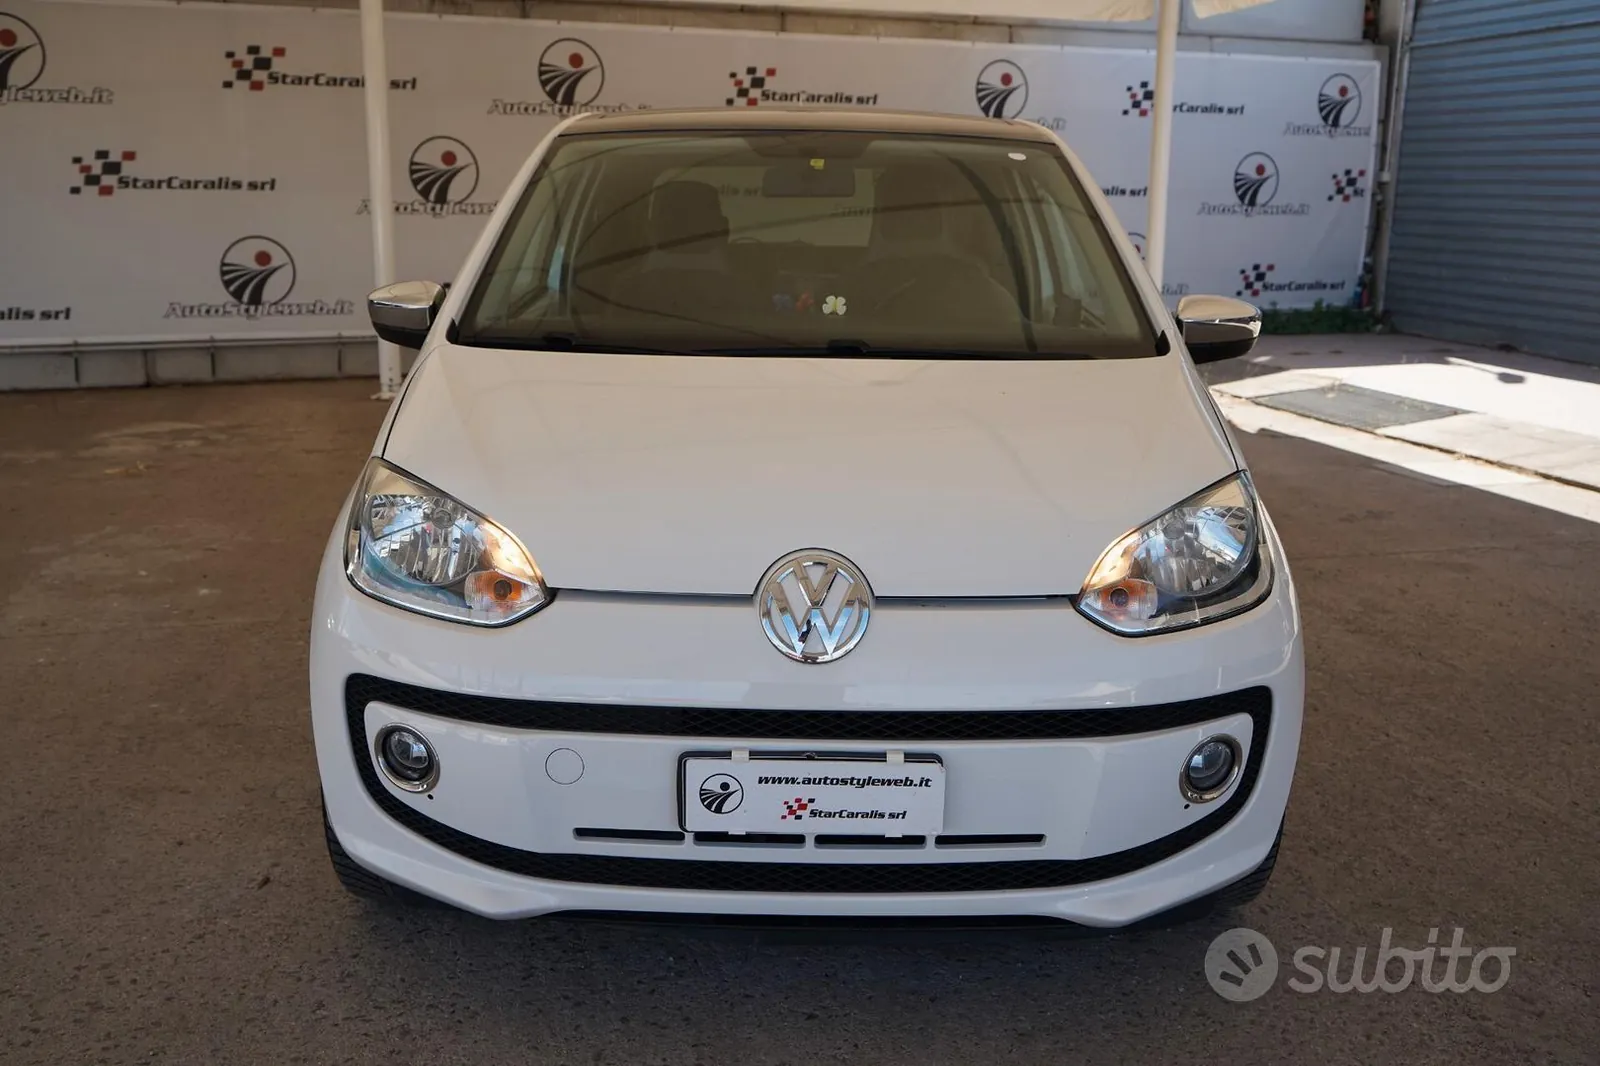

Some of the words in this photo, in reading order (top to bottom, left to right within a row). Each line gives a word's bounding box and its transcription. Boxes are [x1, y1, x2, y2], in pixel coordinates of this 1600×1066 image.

[267, 71, 365, 88] StarCaral
[389, 77, 417, 90] srl
[855, 93, 878, 106] srl
[1226, 104, 1245, 115] srl
[117, 175, 242, 190] StarCaralis
[246, 178, 276, 191] srl
[1129, 185, 1148, 197] srl
[1261, 281, 1327, 292] StarCaralis
[1328, 280, 1346, 291] srl
[39, 306, 71, 321] srl
[163, 299, 355, 320] AutoStyleweb.it
[757, 774, 932, 788] www.autostyleweb.it
[808, 808, 886, 820] StarCaralis
[887, 809, 907, 820] srl
